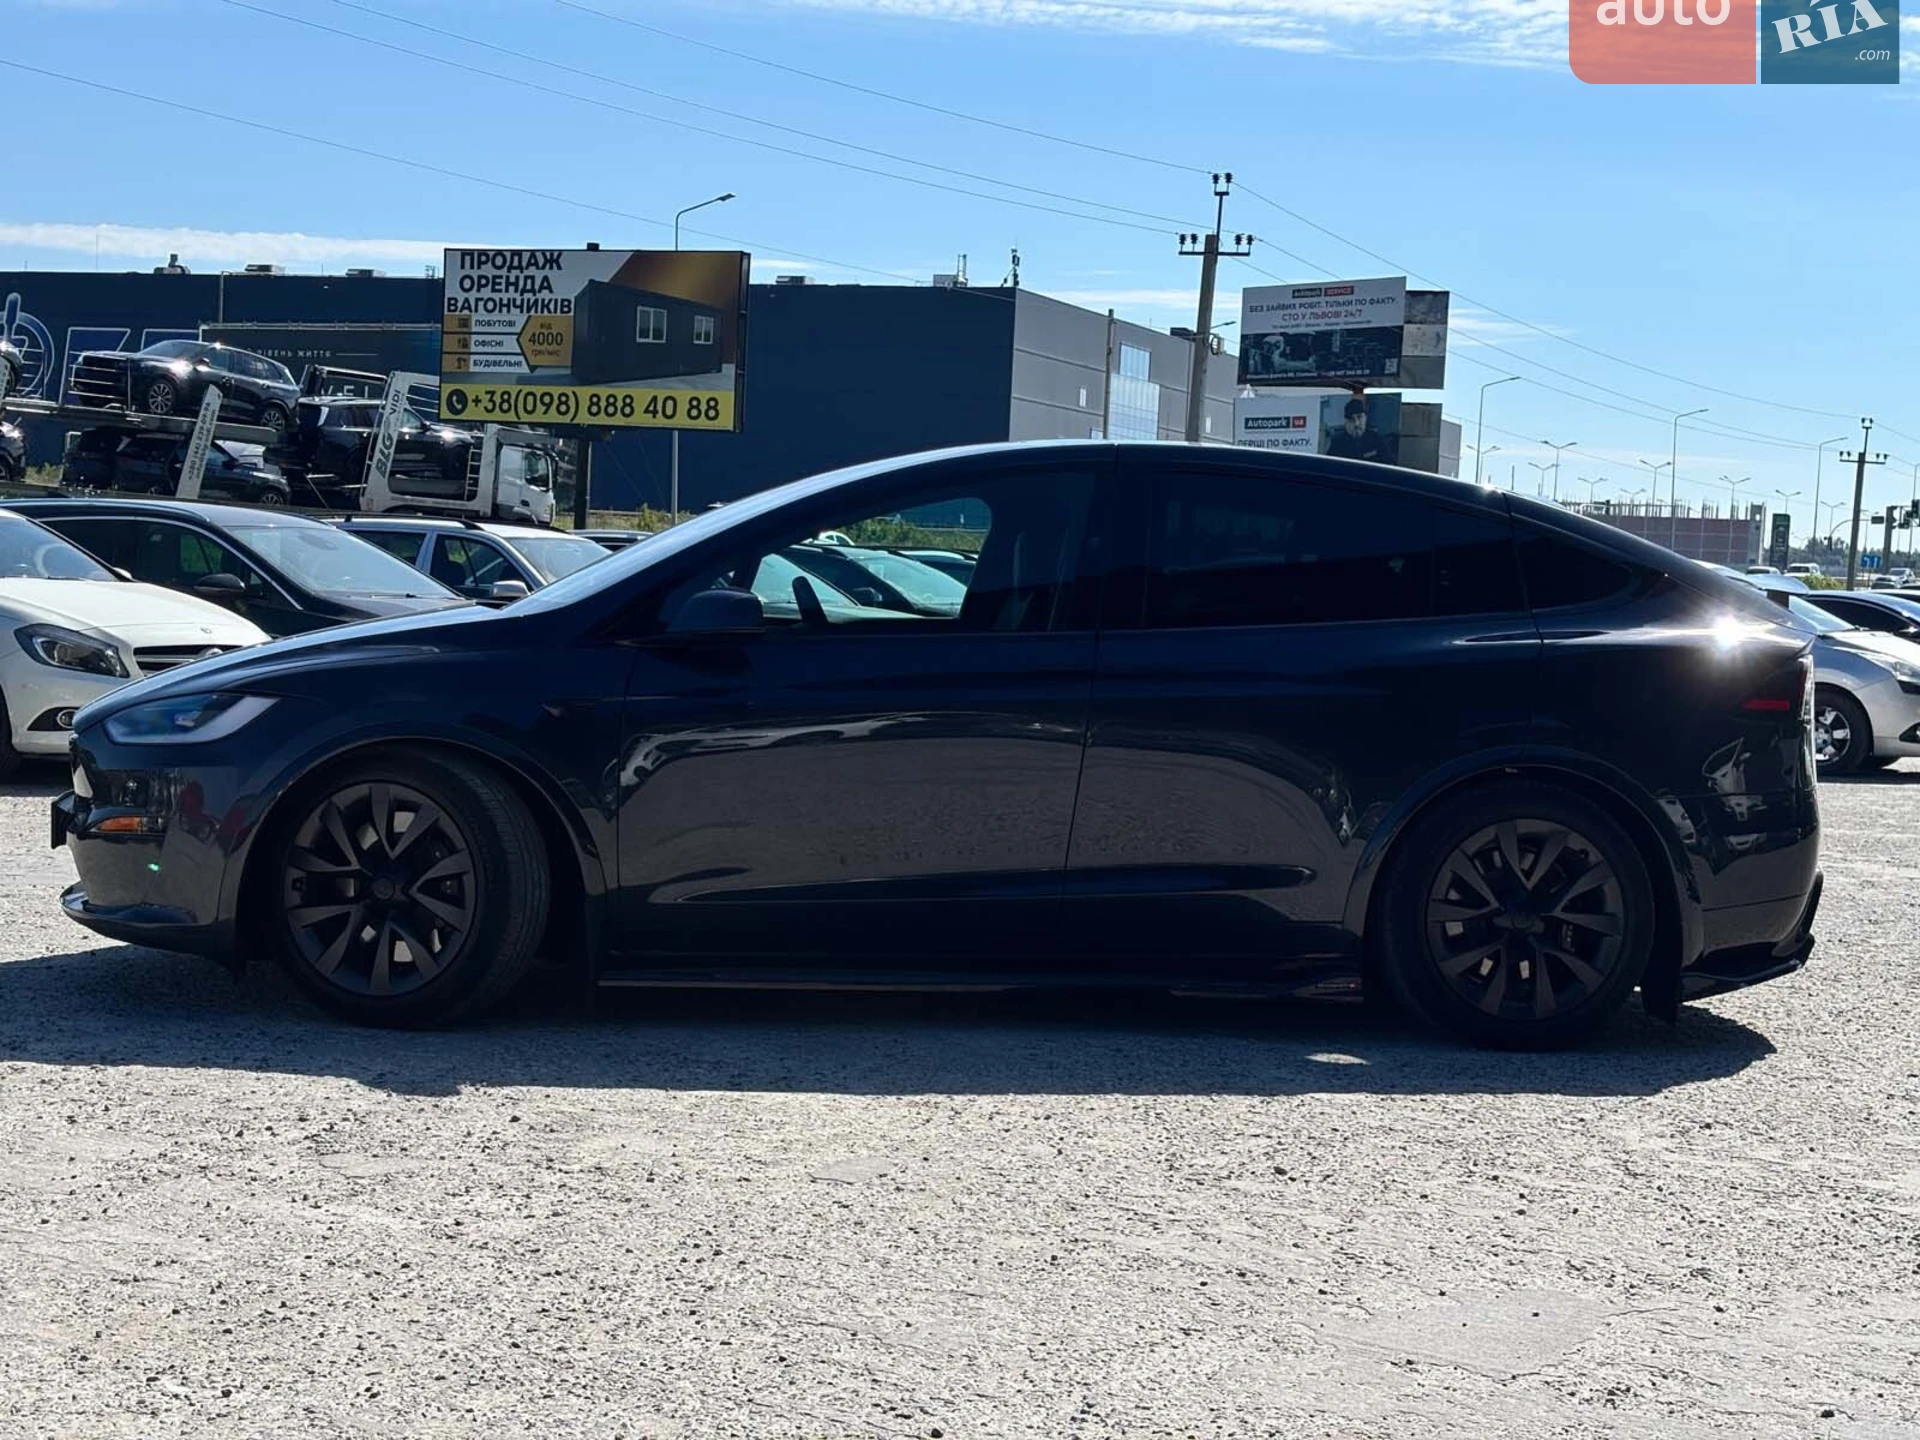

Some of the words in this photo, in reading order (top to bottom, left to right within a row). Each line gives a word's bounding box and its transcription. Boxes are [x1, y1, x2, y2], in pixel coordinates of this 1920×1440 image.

[460, 251, 562, 273] ПРОДАЖ
[459, 274, 553, 296] ОРЕНДА
[446, 297, 572, 314] ВАГОНЧИКІВ
[1282, 313, 1299, 321] СТО
[1301, 312, 1307, 320] У
[1344, 308, 1363, 318] 24/7
[474, 319, 516, 328] ПОБУТОВІ
[473, 340, 504, 348] ОФІСНІ
[528, 332, 563, 346] 4000
[472, 359, 522, 368] БУДІВЕЛЬНІ
[472, 388, 579, 422] +38(098)
[587, 393, 635, 419] 888
[643, 395, 678, 420] 40
[686, 396, 720, 422] 88
[1247, 419, 1288, 427] Autopark
[1267, 439, 1279, 447] ПО
[375, 432, 393, 479] BLG
